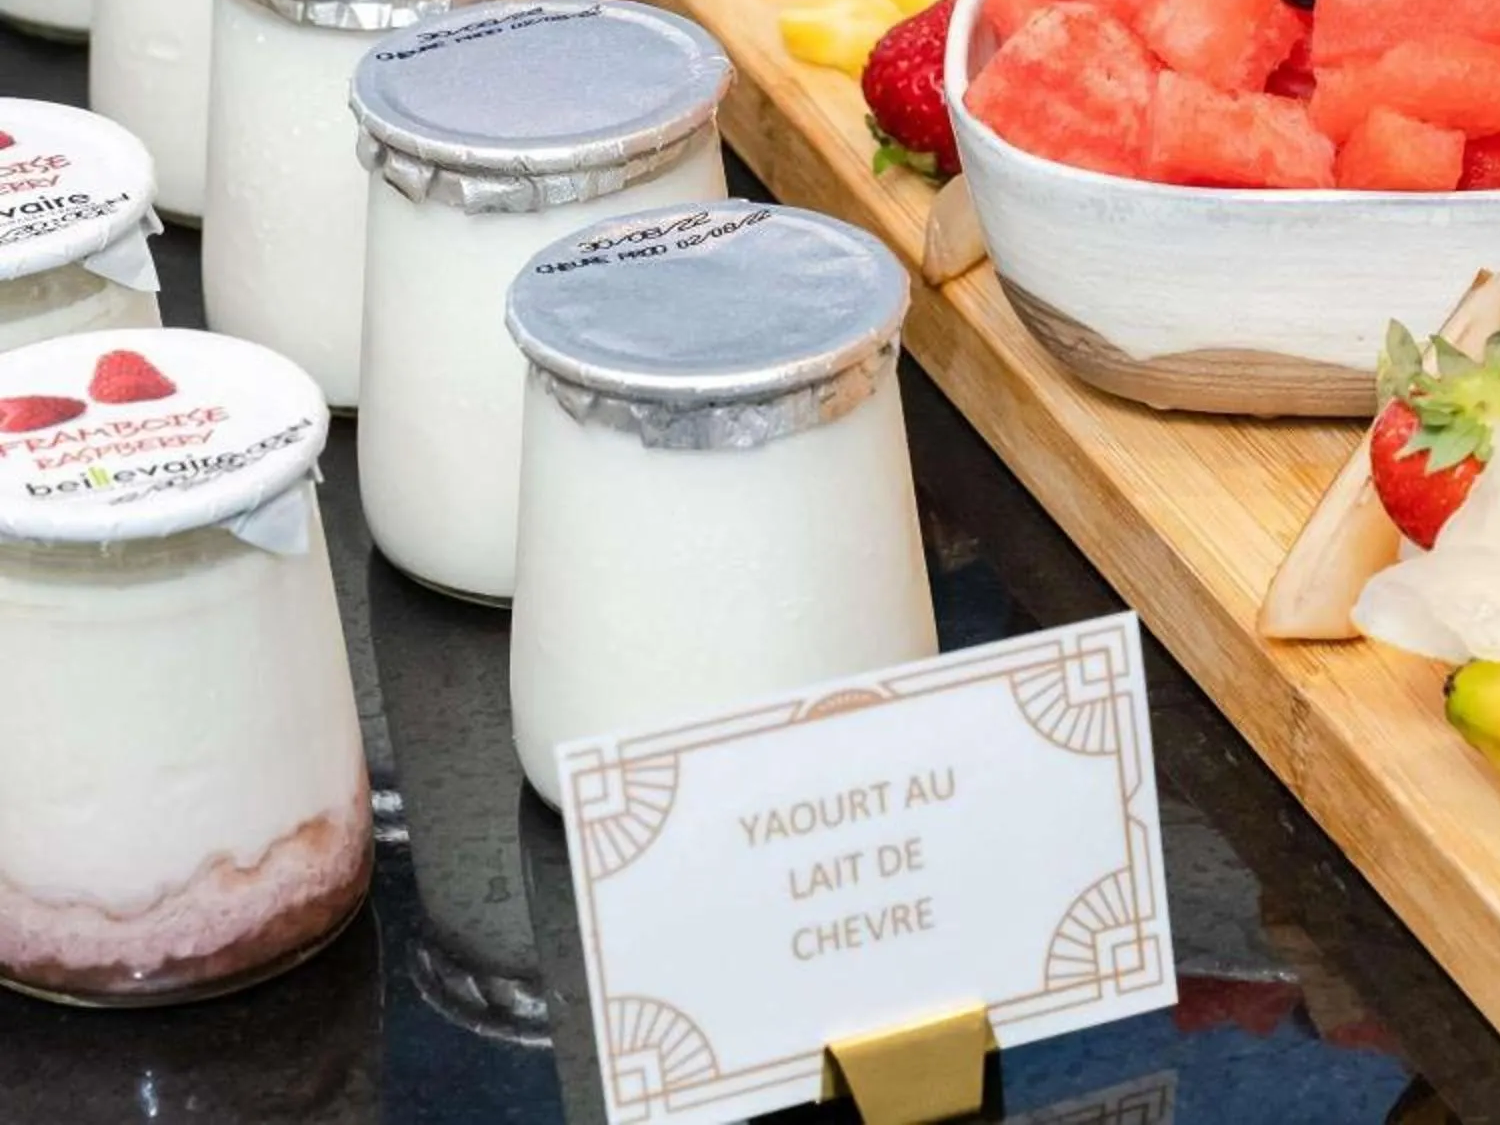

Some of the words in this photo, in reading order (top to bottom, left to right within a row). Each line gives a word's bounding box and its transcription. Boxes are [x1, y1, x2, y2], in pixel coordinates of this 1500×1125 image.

[577, 211, 712, 253] 30/08/22
[0, 406, 230, 458] FRAMBOISE
[33, 429, 215, 470] RASPBERRY
[26, 453, 238, 496] beillevaire
[738, 781, 892, 848] YAOURT
[904, 766, 957, 809] AU
[788, 851, 865, 900] LAIT
[876, 836, 925, 878] DE
[790, 897, 937, 961] CHEVRE
